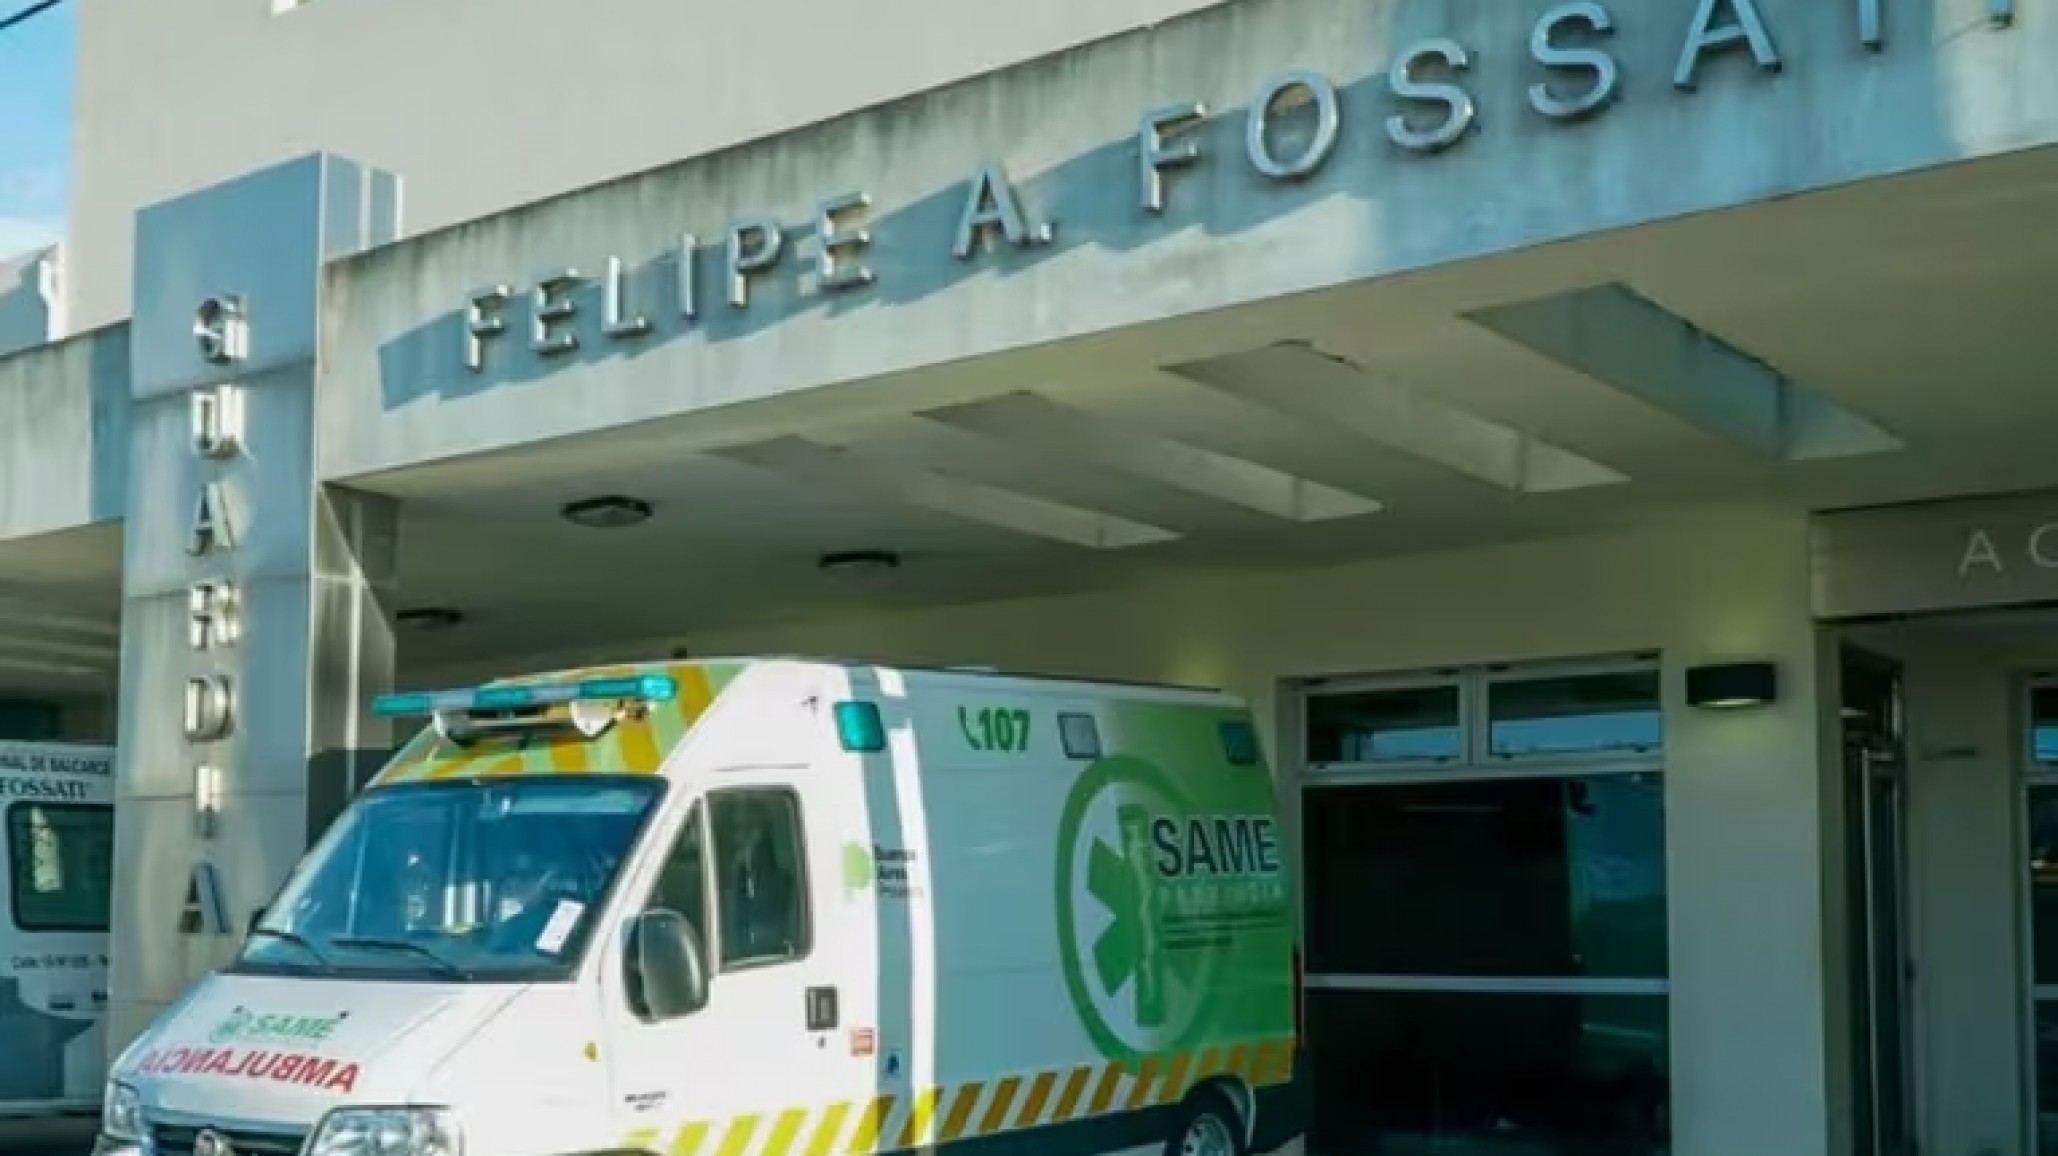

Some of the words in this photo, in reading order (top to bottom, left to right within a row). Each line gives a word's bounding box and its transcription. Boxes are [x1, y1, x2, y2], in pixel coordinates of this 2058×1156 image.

[463, 191, 876, 374] FELIPE
[951, 160, 1057, 262] A.
[178, 295, 250, 934] GUARDIA
[978, 705, 1030, 752] 107
[1153, 818, 1279, 876] SAME
